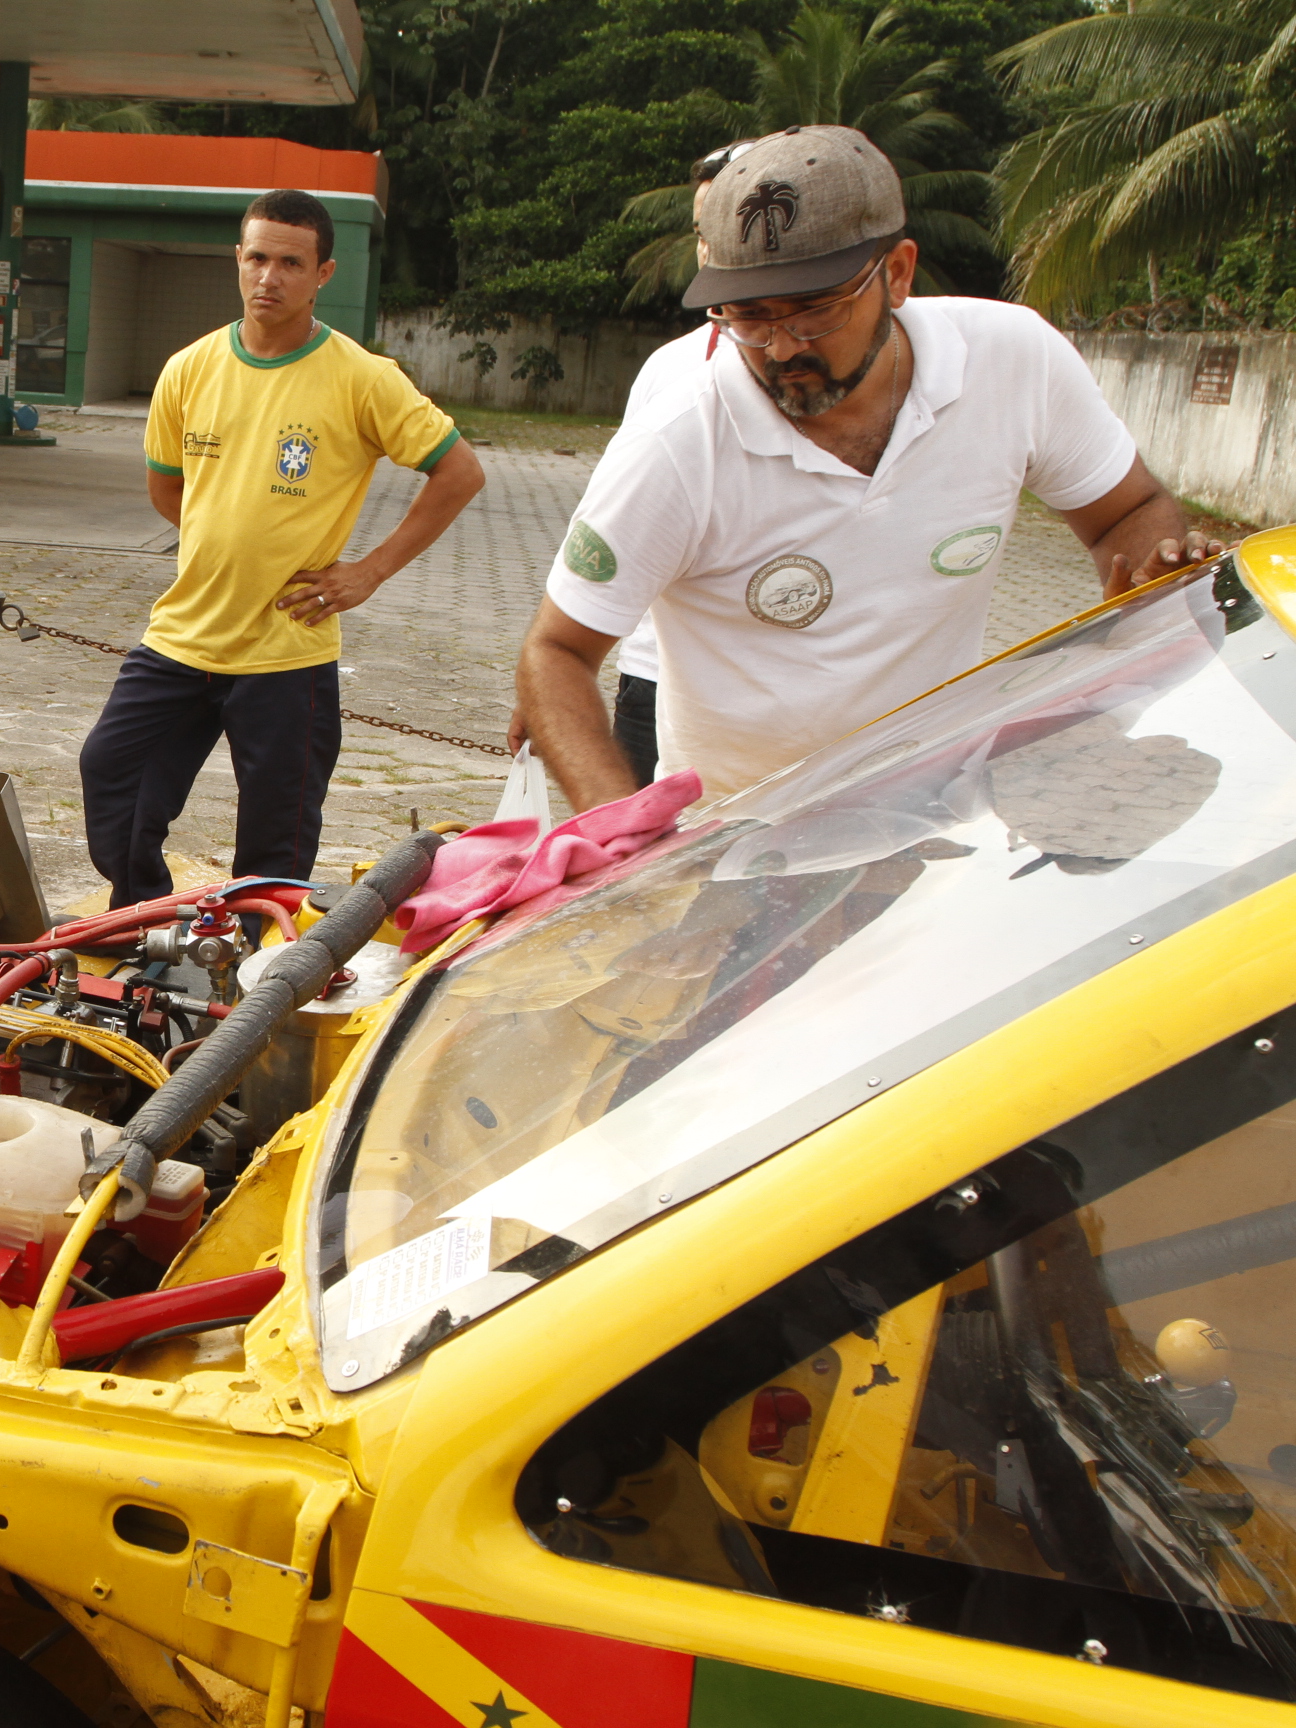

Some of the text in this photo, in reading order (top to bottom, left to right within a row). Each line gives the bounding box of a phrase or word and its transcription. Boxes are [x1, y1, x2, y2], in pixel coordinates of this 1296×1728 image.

[288, 453, 302, 461] CBF
[270, 484, 307, 497] BRASIL
[758, 558, 795, 579] AUTOMÓVEIS
[796, 558, 822, 573] ANTIGOS
[772, 600, 813, 618] ASAAP
